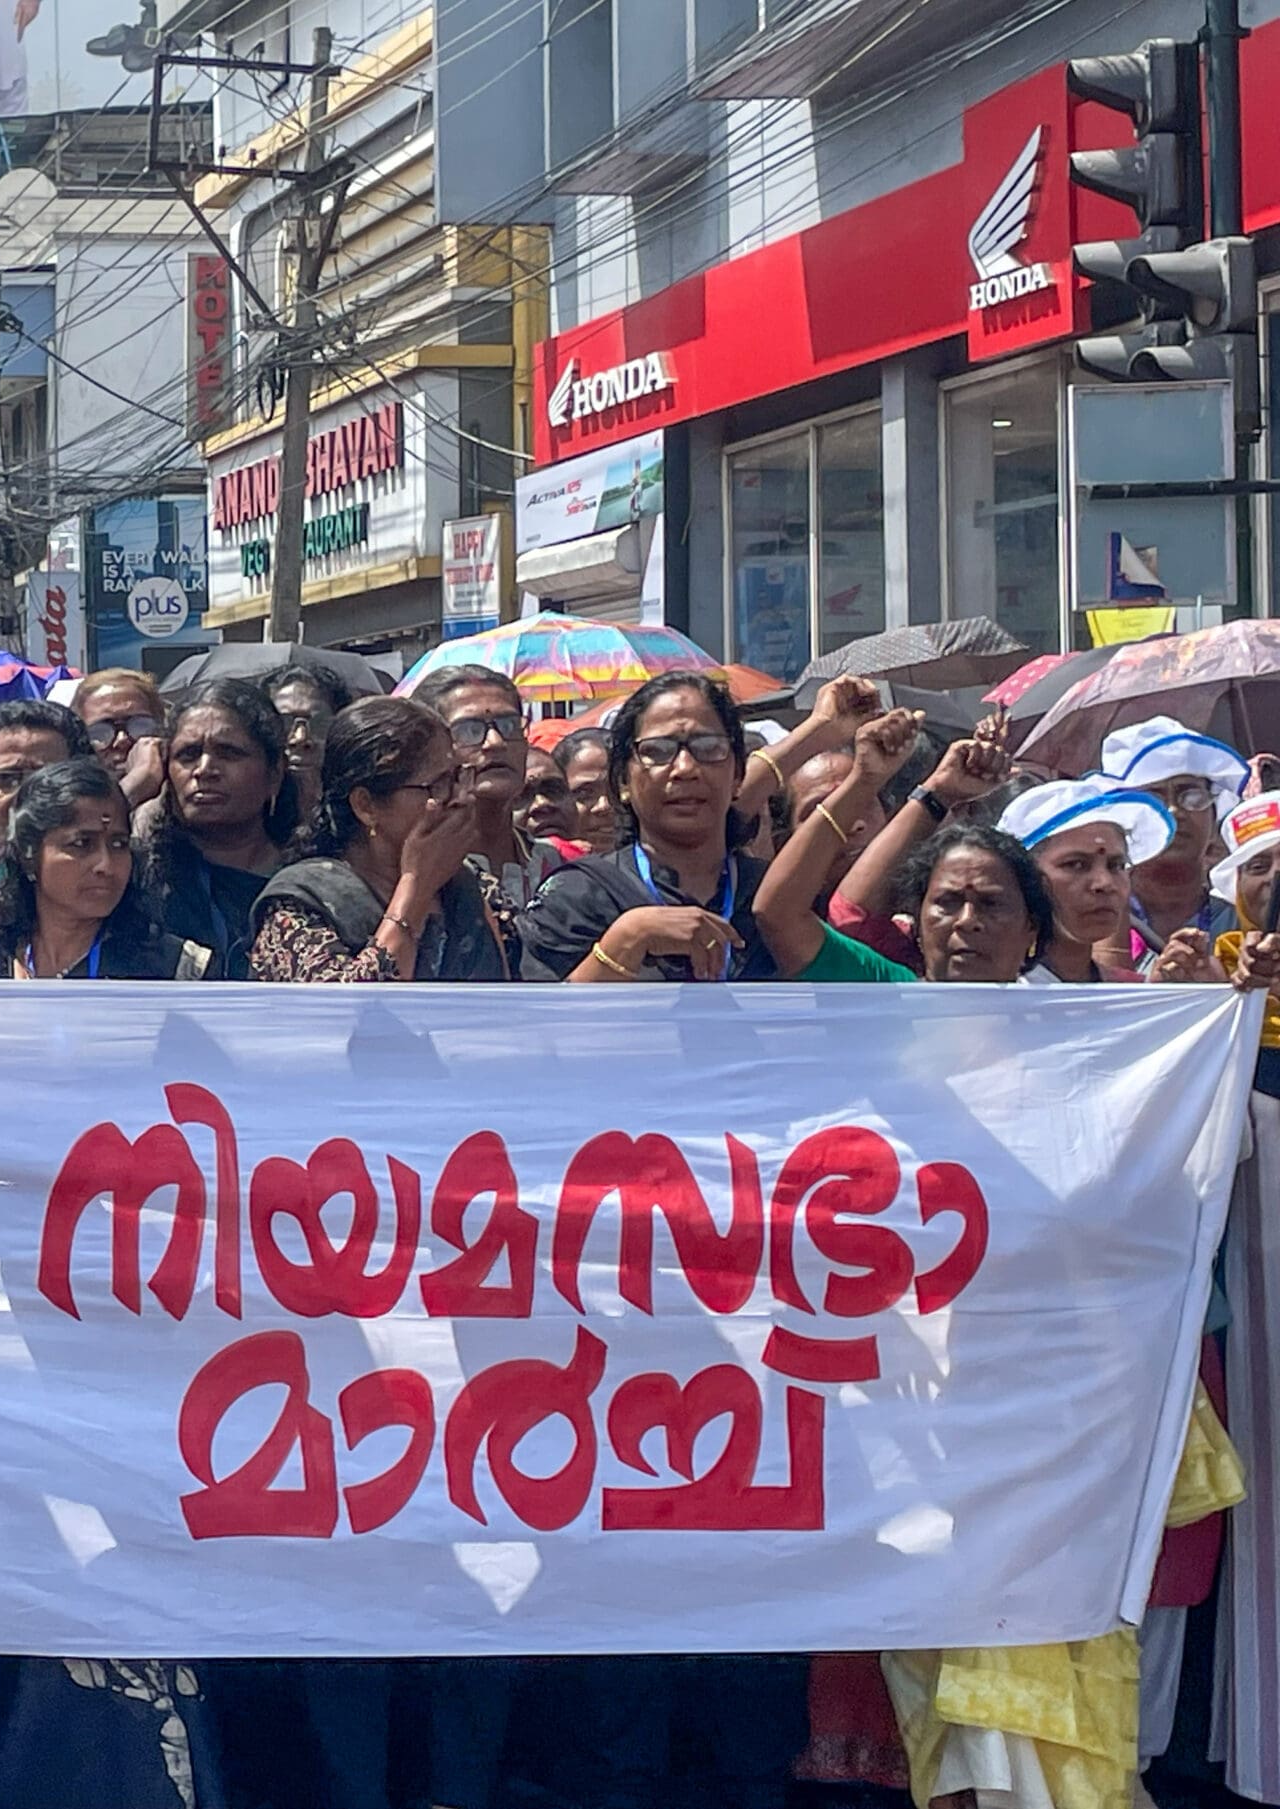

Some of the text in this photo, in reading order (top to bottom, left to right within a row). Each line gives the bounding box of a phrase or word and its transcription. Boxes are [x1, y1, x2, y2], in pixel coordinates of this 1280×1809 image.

[969, 262, 1050, 311] HONDA
[194, 256, 228, 423] HOTEL
[571, 351, 672, 419] HONDA
[305, 402, 402, 500] BHAVAN
[102, 551, 156, 565] EVERY
[103, 565, 135, 578] IS A
[240, 539, 267, 577] VEG
[38, 585, 67, 667] ata
[135, 589, 181, 623] plus
[37, 1083, 989, 1320] നിയമസഭാ
[178, 1324, 881, 1540] മാർച്ച്
